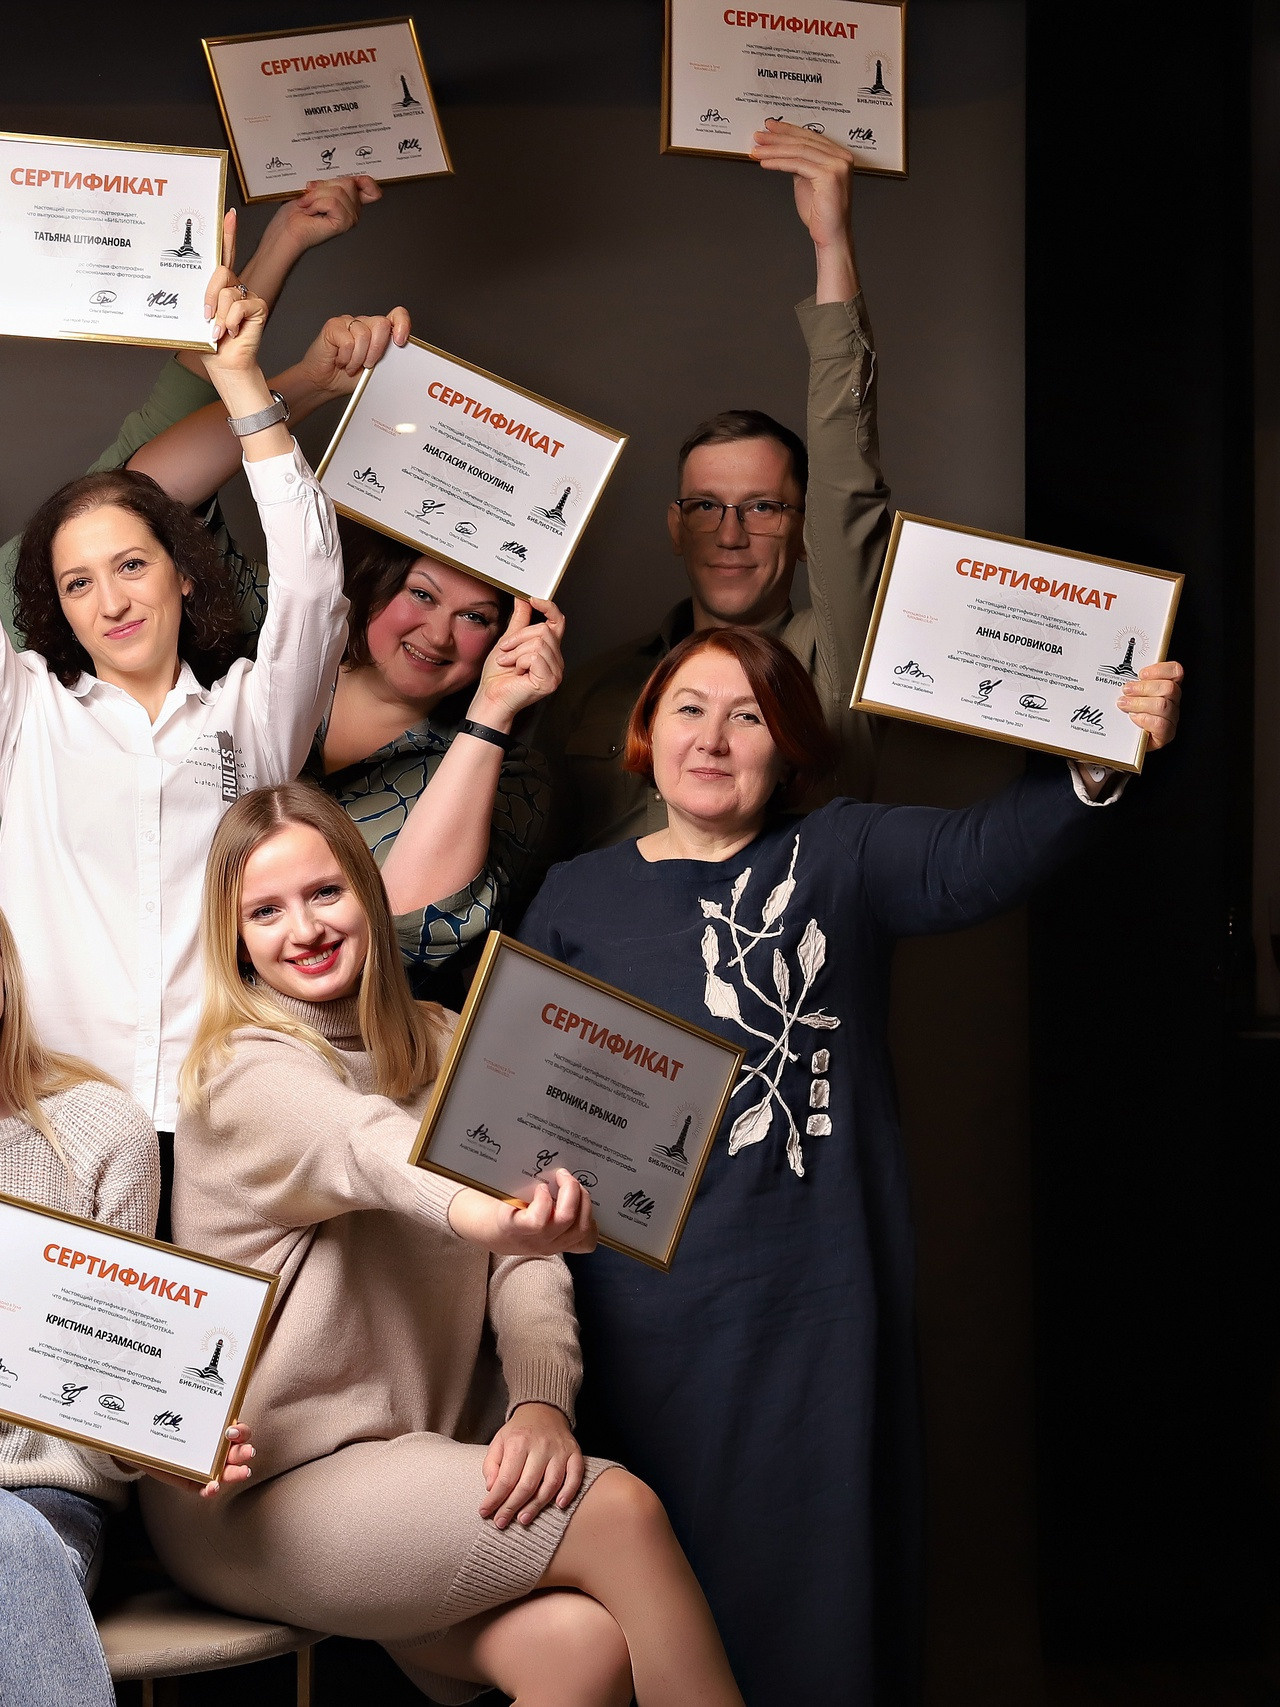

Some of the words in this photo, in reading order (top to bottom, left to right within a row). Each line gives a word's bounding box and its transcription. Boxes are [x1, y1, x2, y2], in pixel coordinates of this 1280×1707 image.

[723, 9, 858, 39] СЕРТИФИКАТ
[260, 47, 376, 75] СЕРТИФИКАТ
[757, 68, 777, 78] ИЛЬЯ
[779, 70, 822, 83] ГРЕБЕЦКИЙ
[303, 105, 332, 116] НИКИТА
[332, 101, 358, 112] ЗУБЦОВ
[857, 98, 893, 106] БИБЛИОТЕКА
[10, 167, 167, 196] СЕРТИФИКАТ
[34, 231, 71, 242] ТАТЬЯНА
[74, 235, 131, 247] ШТИФАНОВА
[159, 261, 201, 269] БИБЛИОТЕКА
[427, 381, 564, 457] СЕРТИФИКАТ
[422, 443, 467, 470] АНАСТАСИЯ
[466, 464, 514, 494] КОКОУЛИНА
[526, 515, 562, 536] БИБЛИОТЕКА
[955, 558, 1117, 610] СЕРТИФИКАТ
[975, 598, 1006, 609] Настоящий
[1007, 606, 1040, 617] сертификат
[975, 626, 1000, 640] АННА
[1002, 632, 1062, 655] БОРОВИКОВА
[956, 650, 980, 658] успешно
[1018, 664, 1043, 673] обучения
[1095, 676, 1124, 686] БИБЛИО
[223, 749, 237, 799] RULES
[541, 1003, 684, 1081] СЕРТИФИКАТ
[545, 1084, 588, 1112] ВЕРОНИКА
[588, 1103, 627, 1129] БРЫКАЛО
[647, 1156, 684, 1177] БИБЛИОТЕКА
[43, 1243, 208, 1308] СЕРТИФИКАТ
[60, 1287, 93, 1301] Настоящий
[93, 1298, 126, 1311] сертификат
[45, 1313, 93, 1336] КРИСТИНА
[94, 1329, 161, 1358] АРЗАМАСКОВА
[38, 1342, 62, 1352] успешно
[101, 1362, 126, 1372] обучения
[56, 1355, 73, 1364] старт
[178, 1378, 222, 1396] БИБЛИОТЕКА
